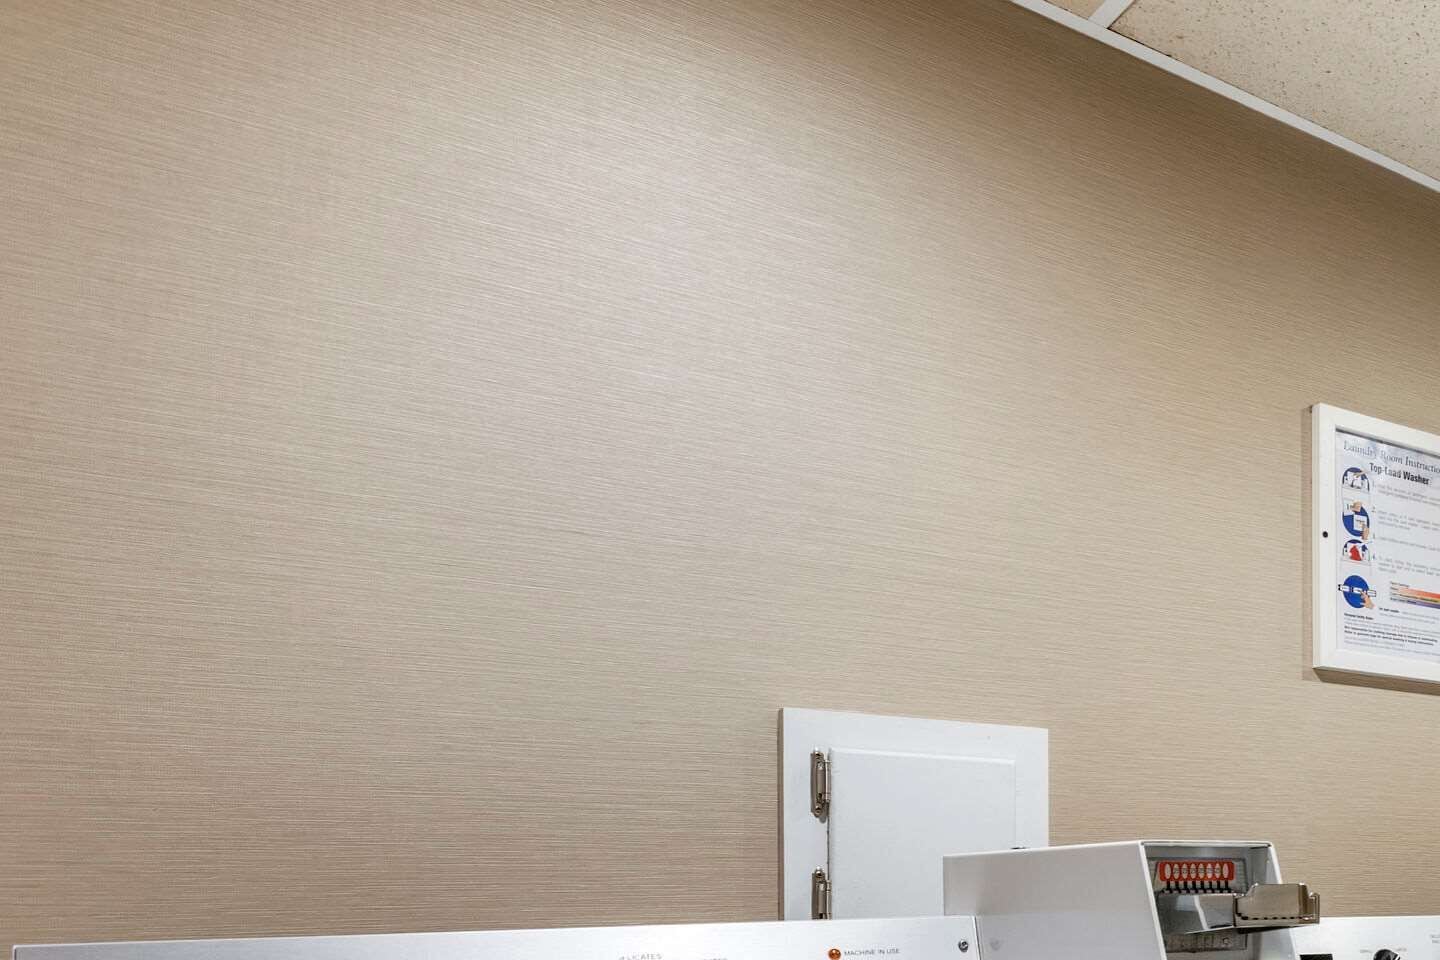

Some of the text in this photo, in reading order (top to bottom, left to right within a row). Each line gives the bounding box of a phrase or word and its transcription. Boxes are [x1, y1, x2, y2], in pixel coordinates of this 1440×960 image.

[1344, 440, 1377, 459] Laundry
[1381, 450, 1402, 464] Room
[1369, 462, 1430, 485] Top-Load Washer
[886, 947, 901, 955] USE
